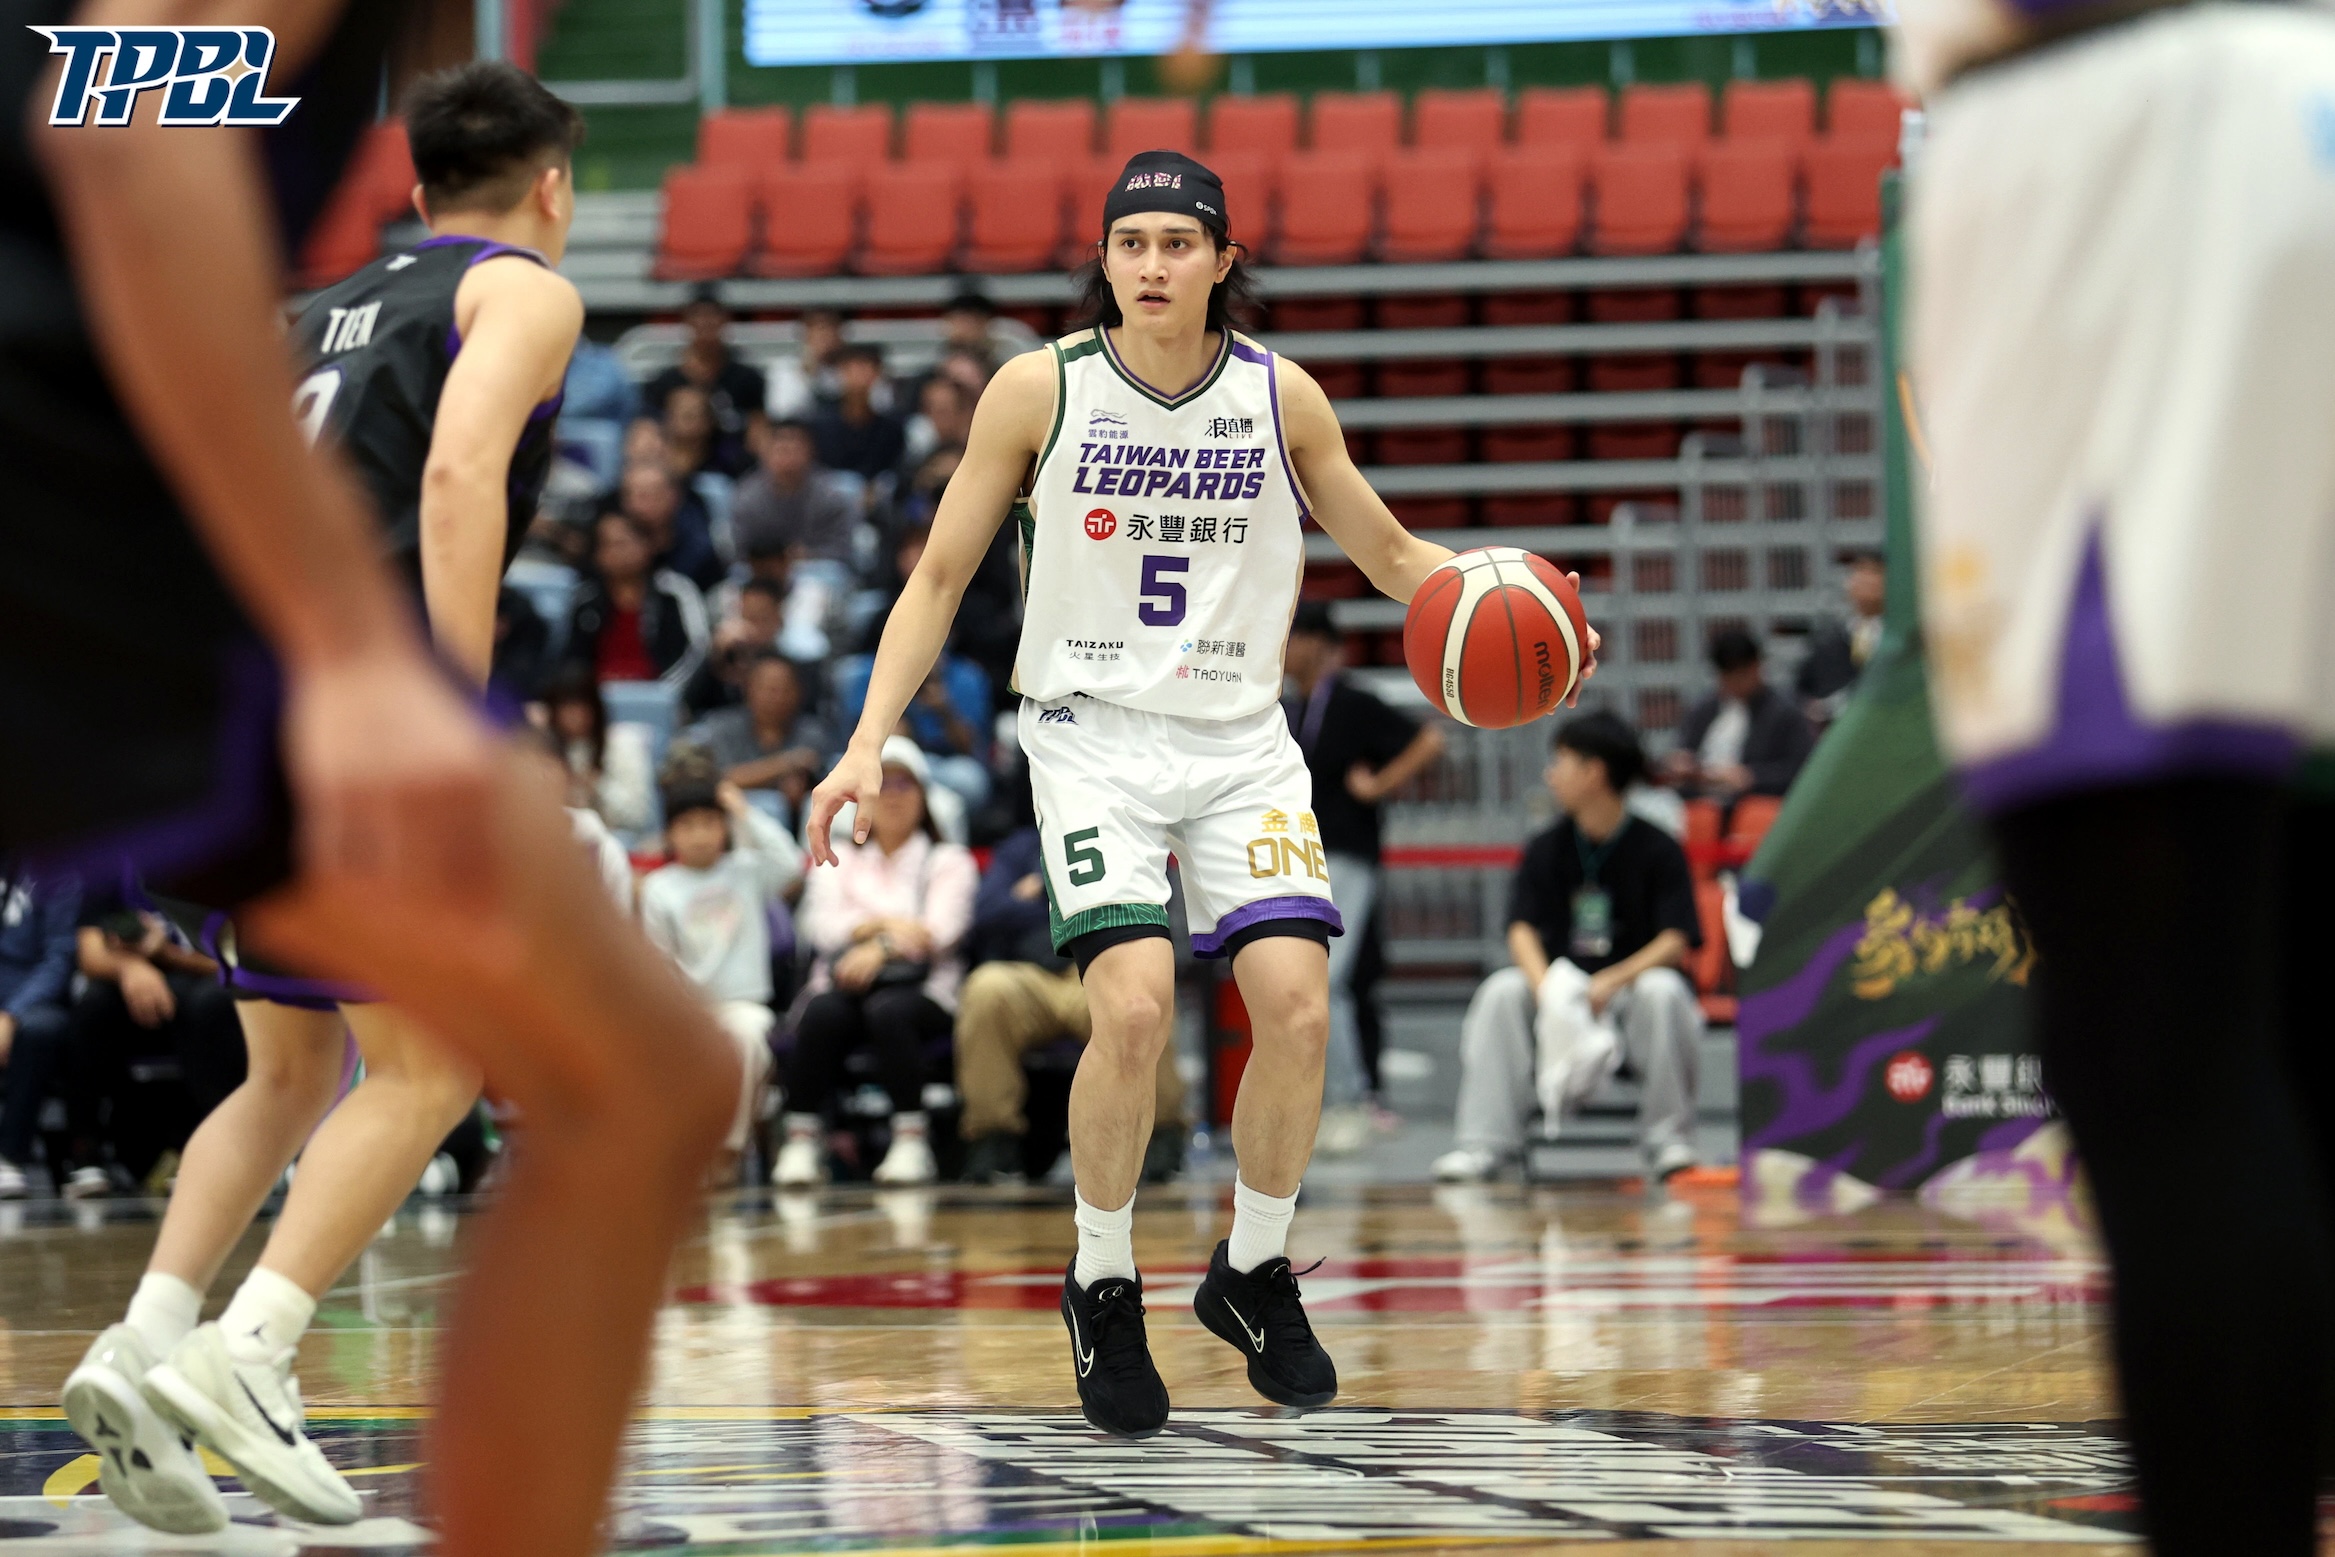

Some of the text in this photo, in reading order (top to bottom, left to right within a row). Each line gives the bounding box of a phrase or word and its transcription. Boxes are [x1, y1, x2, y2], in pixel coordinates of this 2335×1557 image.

[320, 301, 383, 354] TIEN
[1088, 429, 1129, 439] 雲豹能源
[1204, 417, 1253, 439] 浪直播
[1079, 443, 1266, 469] TAIWAN BEER
[1072, 466, 1266, 500] LEOPARDS
[1126, 514, 1249, 544] 永豐銀行
[1138, 555, 1190, 627] 5
[1066, 639, 1124, 650] TAIZAKU
[1069, 651, 1121, 661] 火星生技
[1196, 639, 1246, 658] 聯新運醫
[1192, 668, 1242, 683] TAOYUAN
[1445, 667, 1455, 698] BG4550
[1534, 641, 1555, 710] molten
[1261, 808, 1317, 837] 金牌
[1063, 826, 1106, 887] 5
[1246, 837, 1329, 883] ONE
